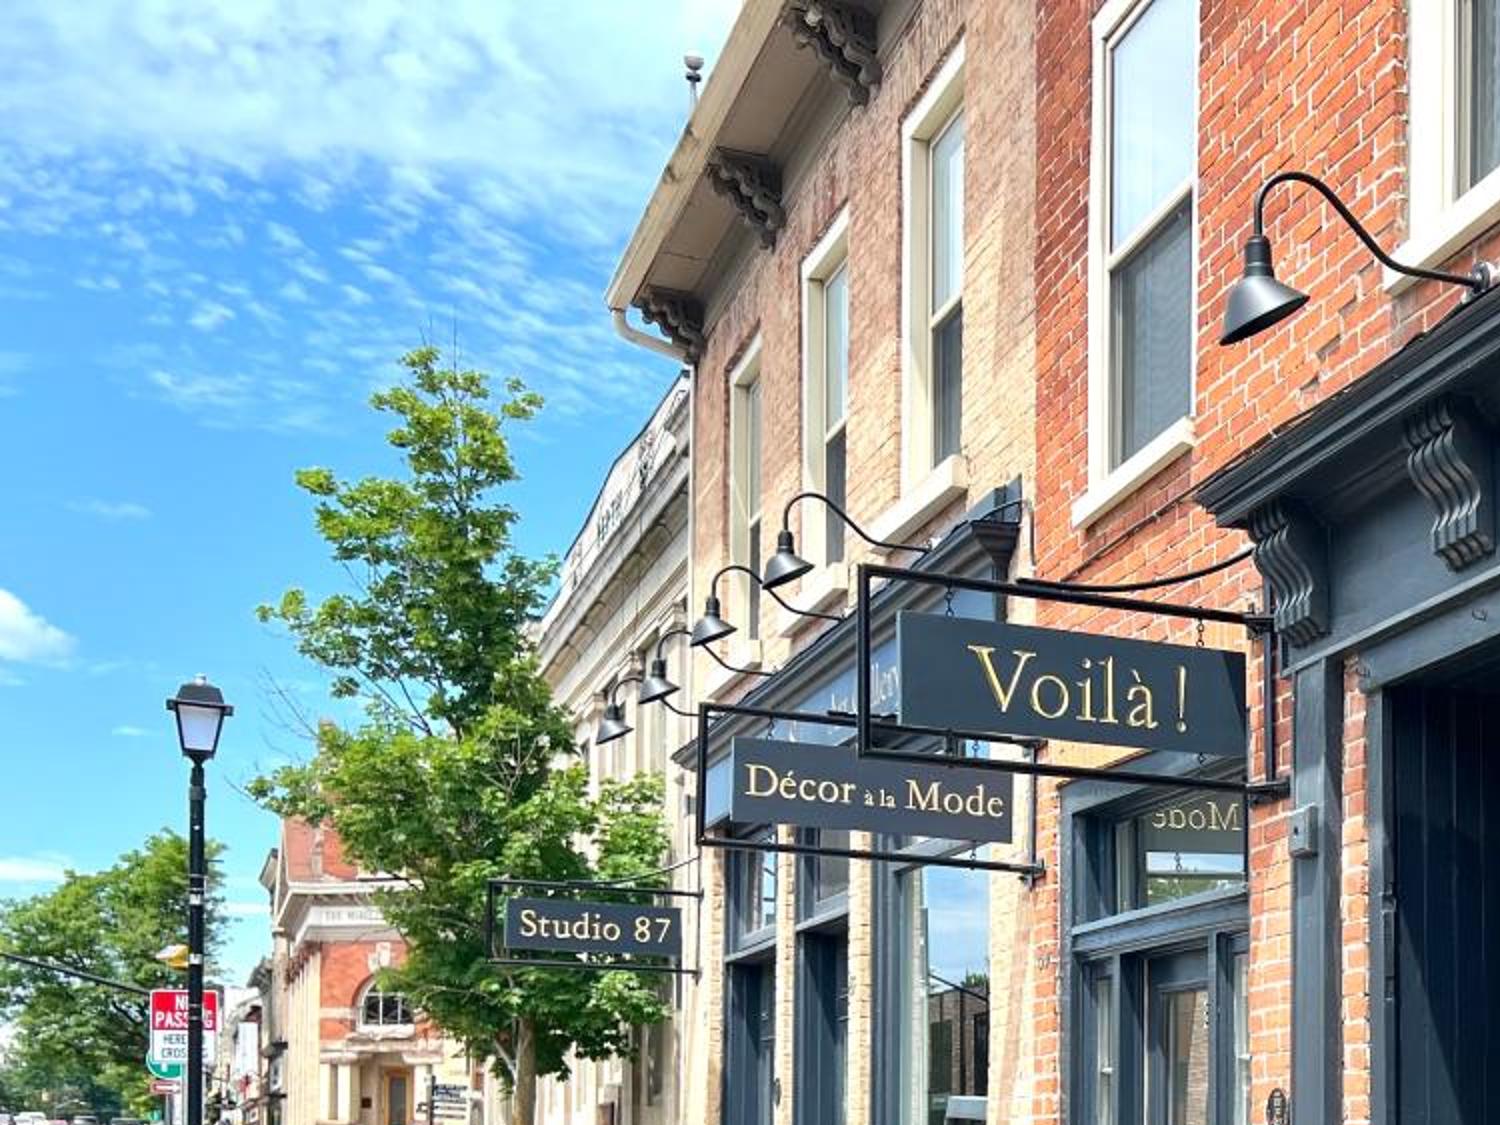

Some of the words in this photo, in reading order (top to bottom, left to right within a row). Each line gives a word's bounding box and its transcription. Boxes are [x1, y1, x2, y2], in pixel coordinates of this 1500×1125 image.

[744, 763, 857, 804] Décor
[863, 790, 874, 807] à
[880, 789, 897, 809] la
[905, 778, 1005, 818] Mode
[520, 909, 621, 942] Studio
[634, 915, 671, 944] 87
